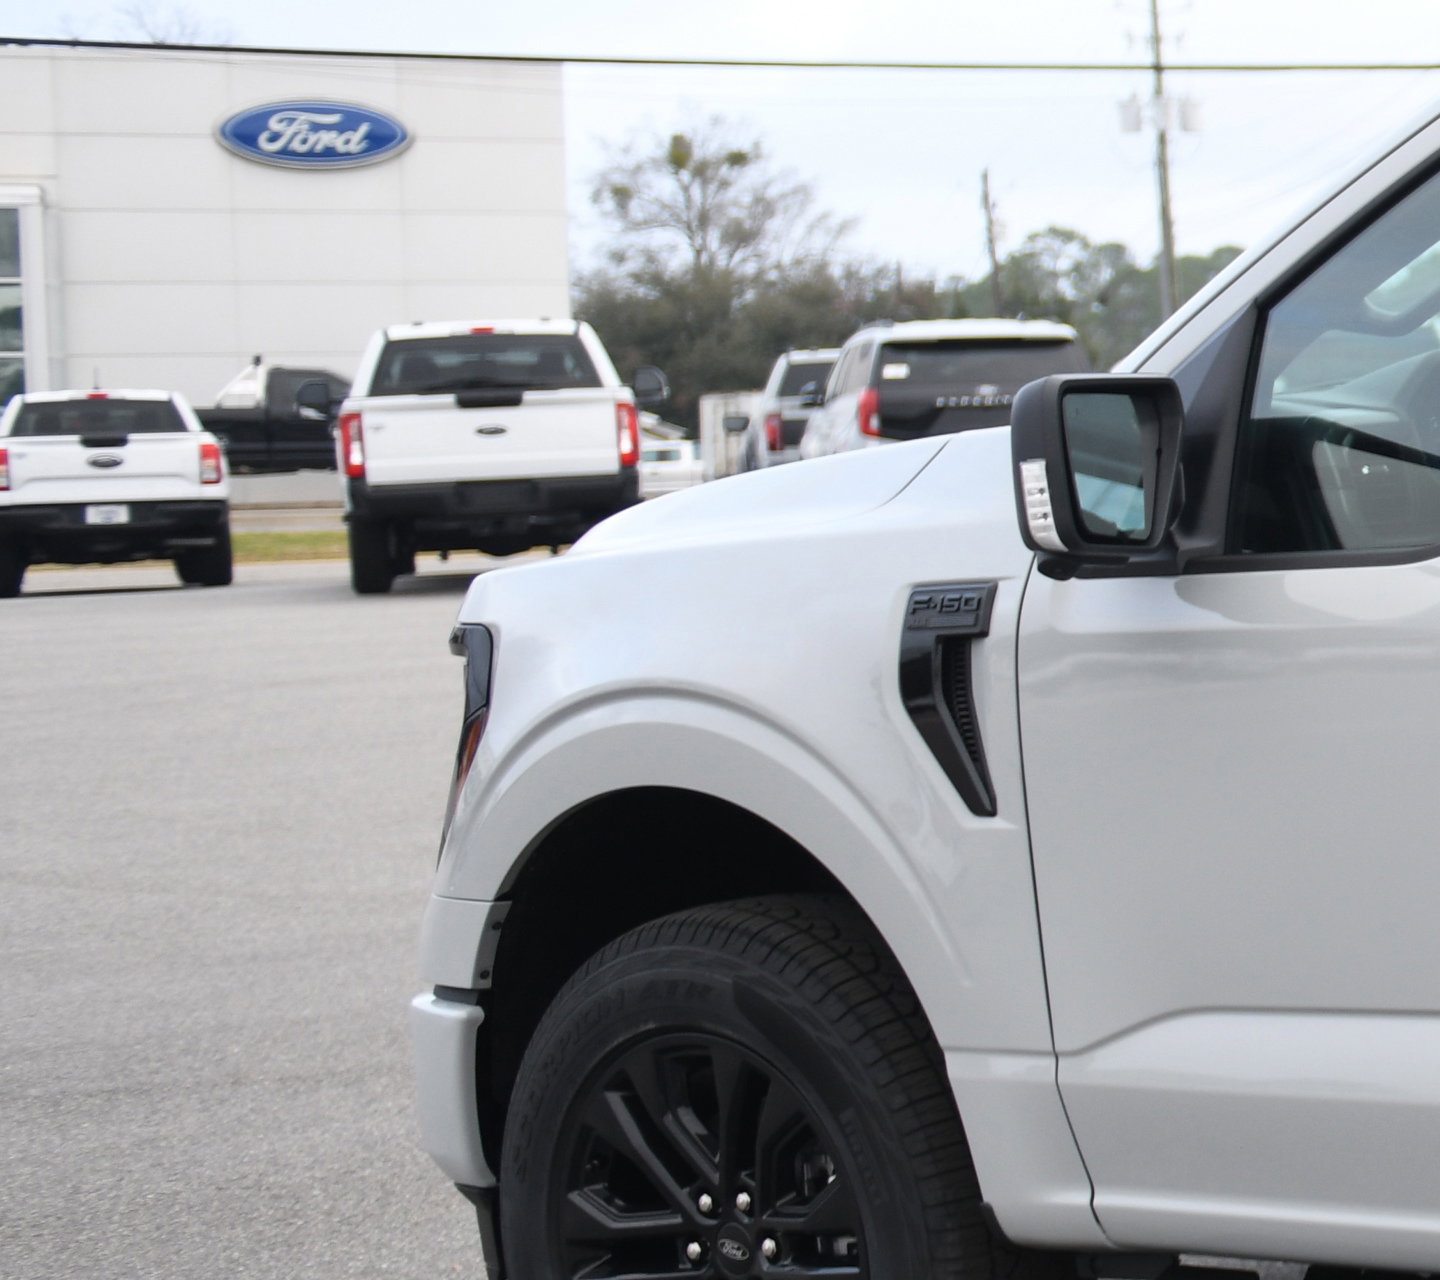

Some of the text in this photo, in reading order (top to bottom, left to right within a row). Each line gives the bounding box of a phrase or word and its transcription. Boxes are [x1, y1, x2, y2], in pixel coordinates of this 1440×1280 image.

[258, 111, 371, 153] Ford
[908, 592, 982, 615] F-150
[722, 1240, 743, 1259] Ford
